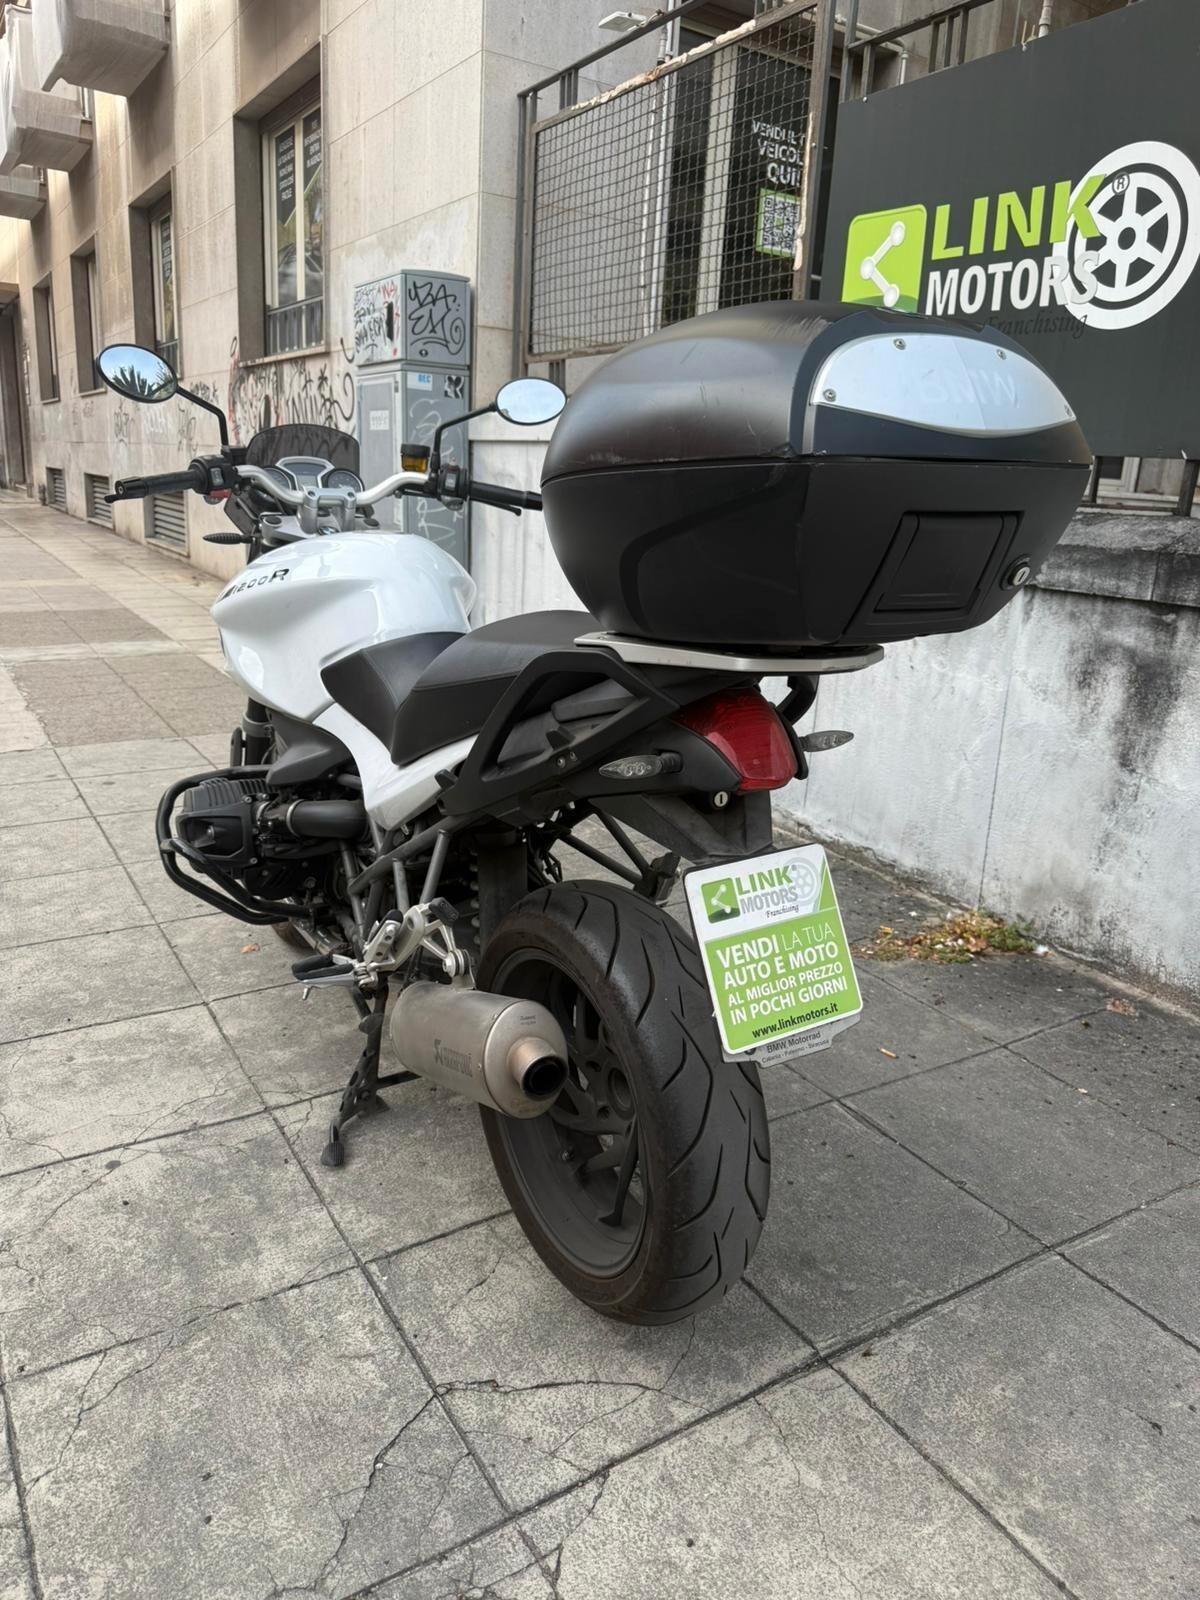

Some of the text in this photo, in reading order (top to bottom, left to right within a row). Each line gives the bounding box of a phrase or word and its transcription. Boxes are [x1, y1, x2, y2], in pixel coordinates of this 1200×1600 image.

[752, 119, 786, 141] VENDI
[757, 138, 804, 166] VEICOL
[931, 173, 1107, 260] LINK
[925, 250, 1100, 316] MOTORS
[985, 306, 1088, 340] Franchising
[734, 865, 794, 896] LINK
[740, 886, 799, 914] MOTORS
[765, 903, 800, 919] Franchising
[716, 922, 835, 969] VENDI LA TUA
[724, 941, 839, 990] AUTO E MOTO
[728, 961, 843, 1007] AL MIGLIOR PREZZO
[730, 975, 848, 1025] IN POCHI GIORNI
[752, 1002, 839, 1039] www.linkmotors.it
[766, 1030, 821, 1053] BMW Motorrad
